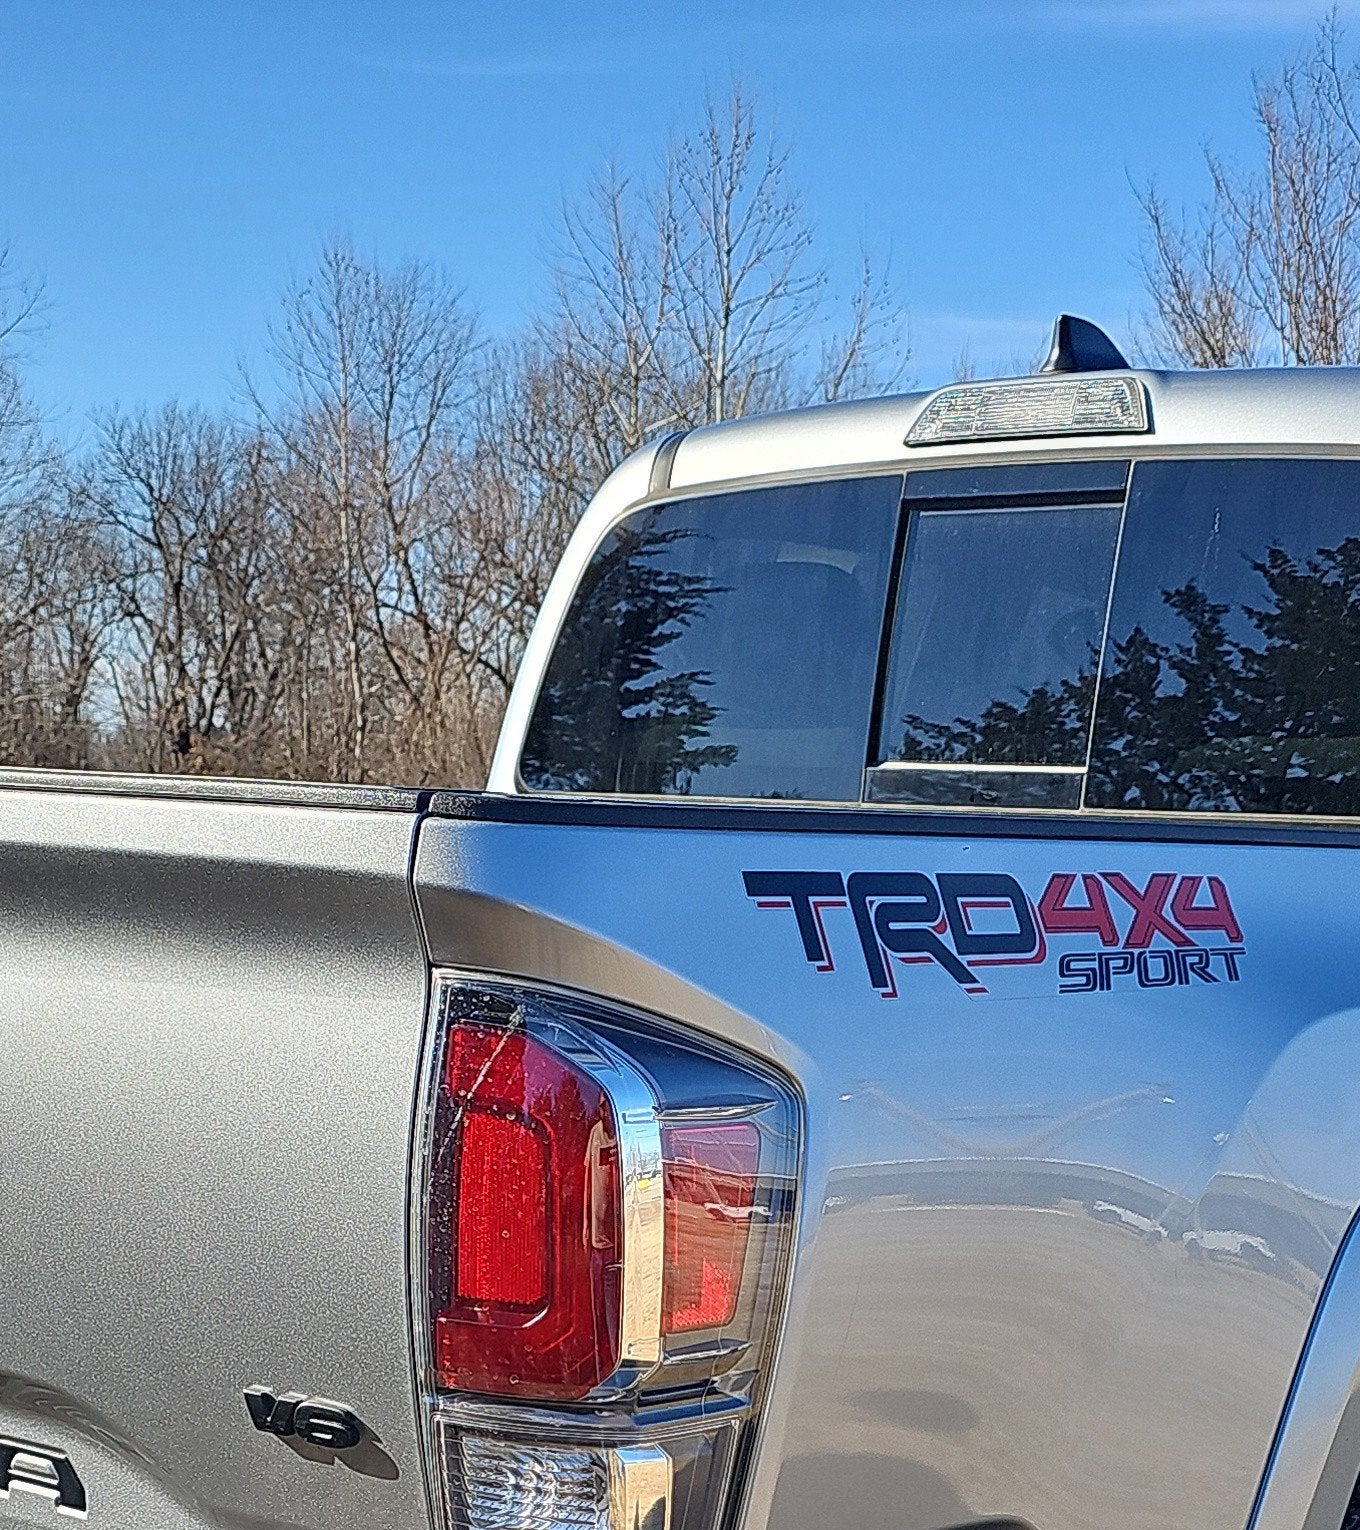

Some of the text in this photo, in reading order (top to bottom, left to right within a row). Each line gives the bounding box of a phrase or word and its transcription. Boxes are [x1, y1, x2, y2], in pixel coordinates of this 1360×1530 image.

[741, 870, 1245, 999] TRD 4X4
[1058, 947, 1246, 995] SPORT
